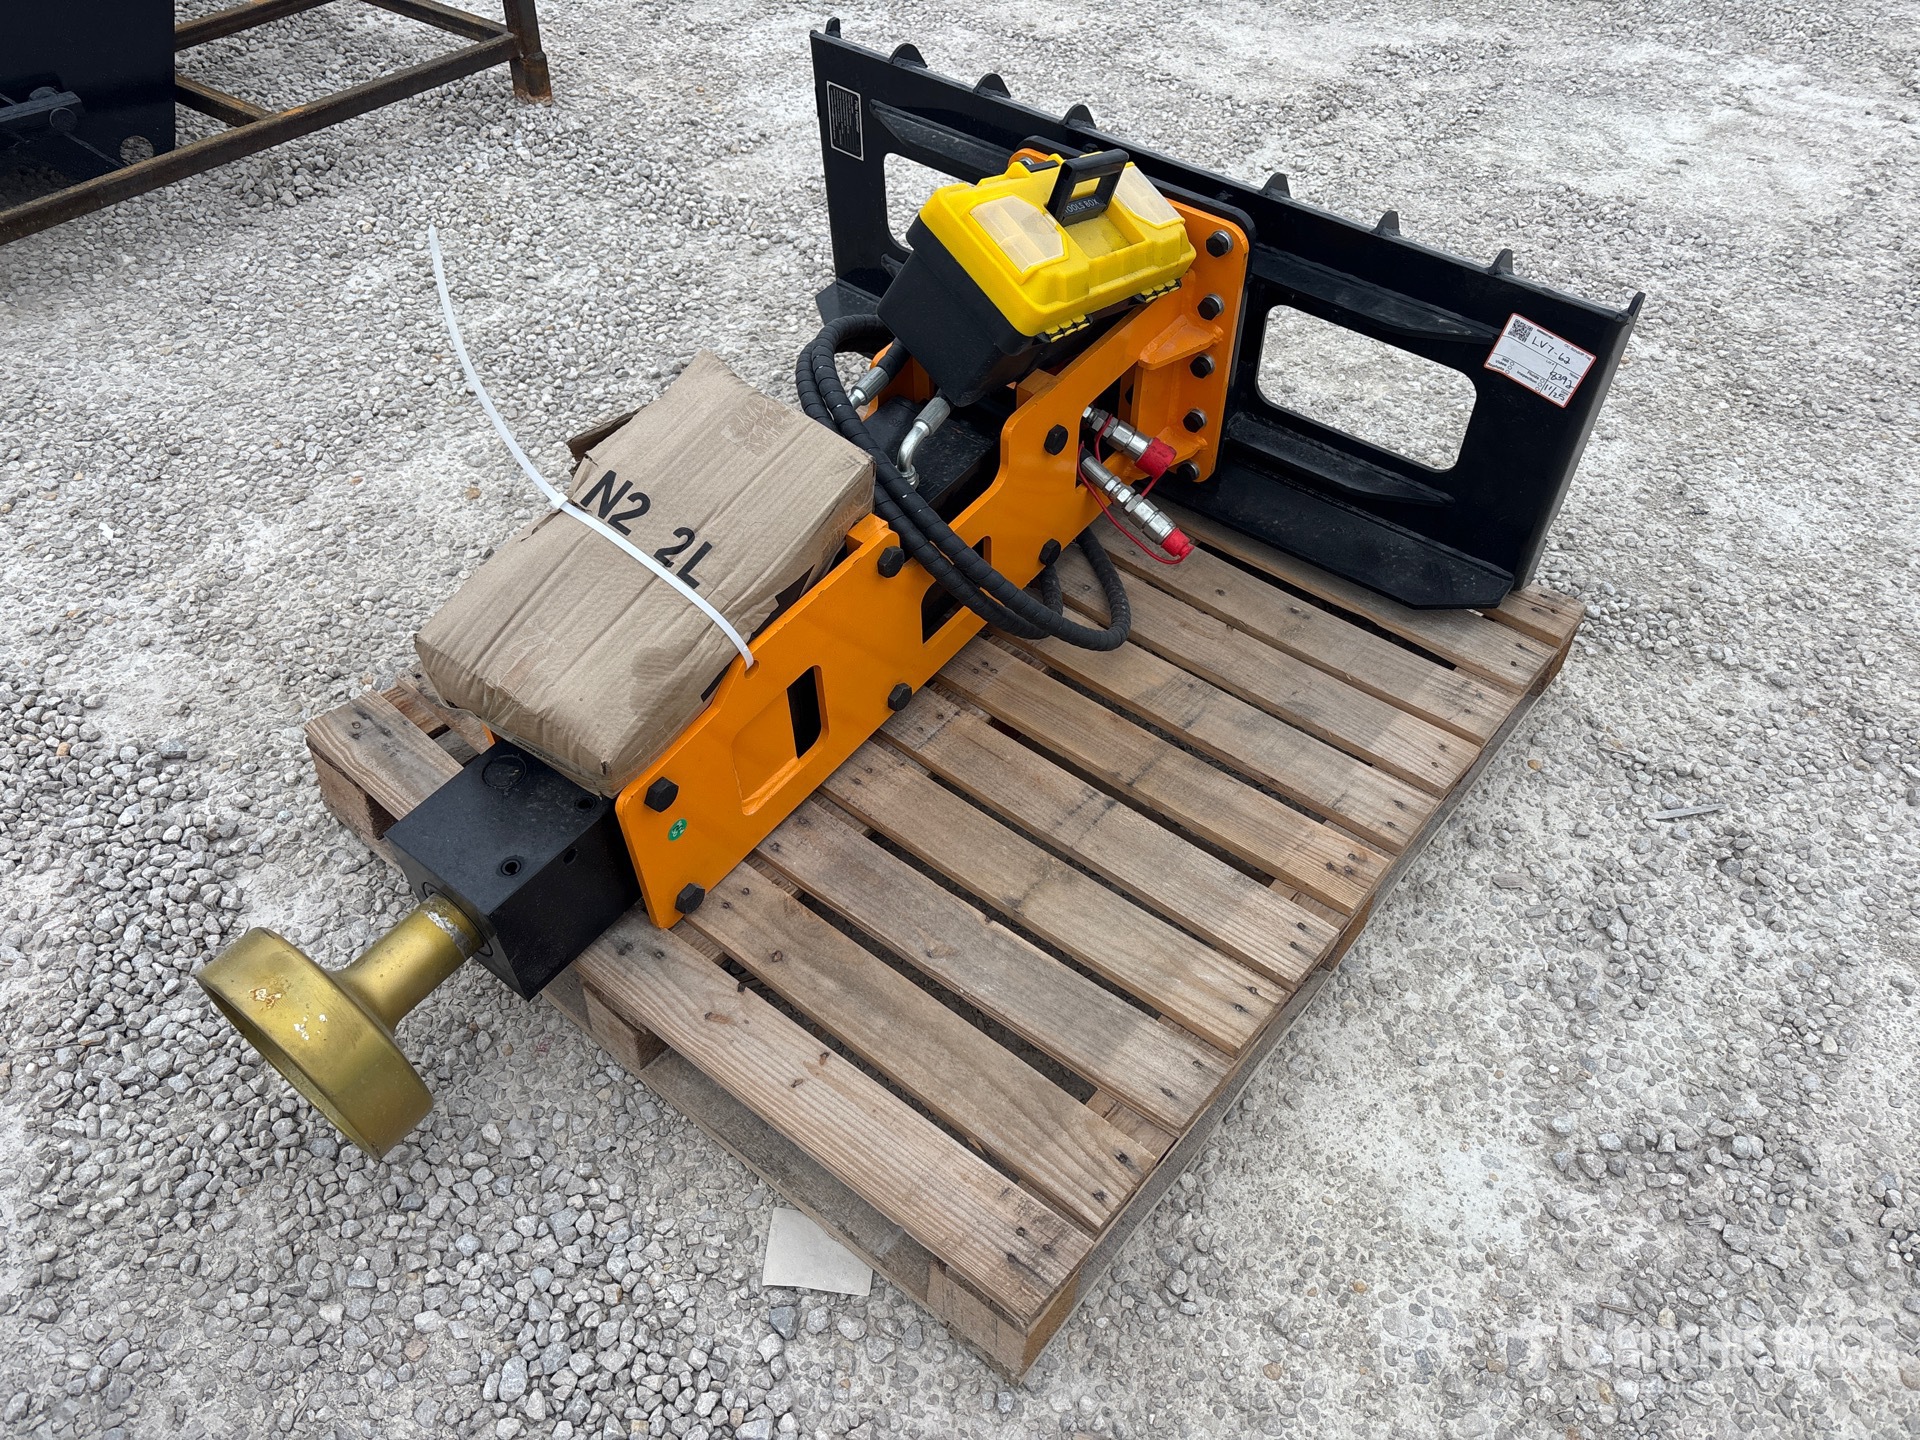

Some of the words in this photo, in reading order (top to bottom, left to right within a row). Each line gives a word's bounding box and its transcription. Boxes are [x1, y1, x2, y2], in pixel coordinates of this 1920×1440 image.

[1084, 198, 1100, 207] BOX
[580, 469, 651, 536] N2
[653, 527, 713, 590] 2L
